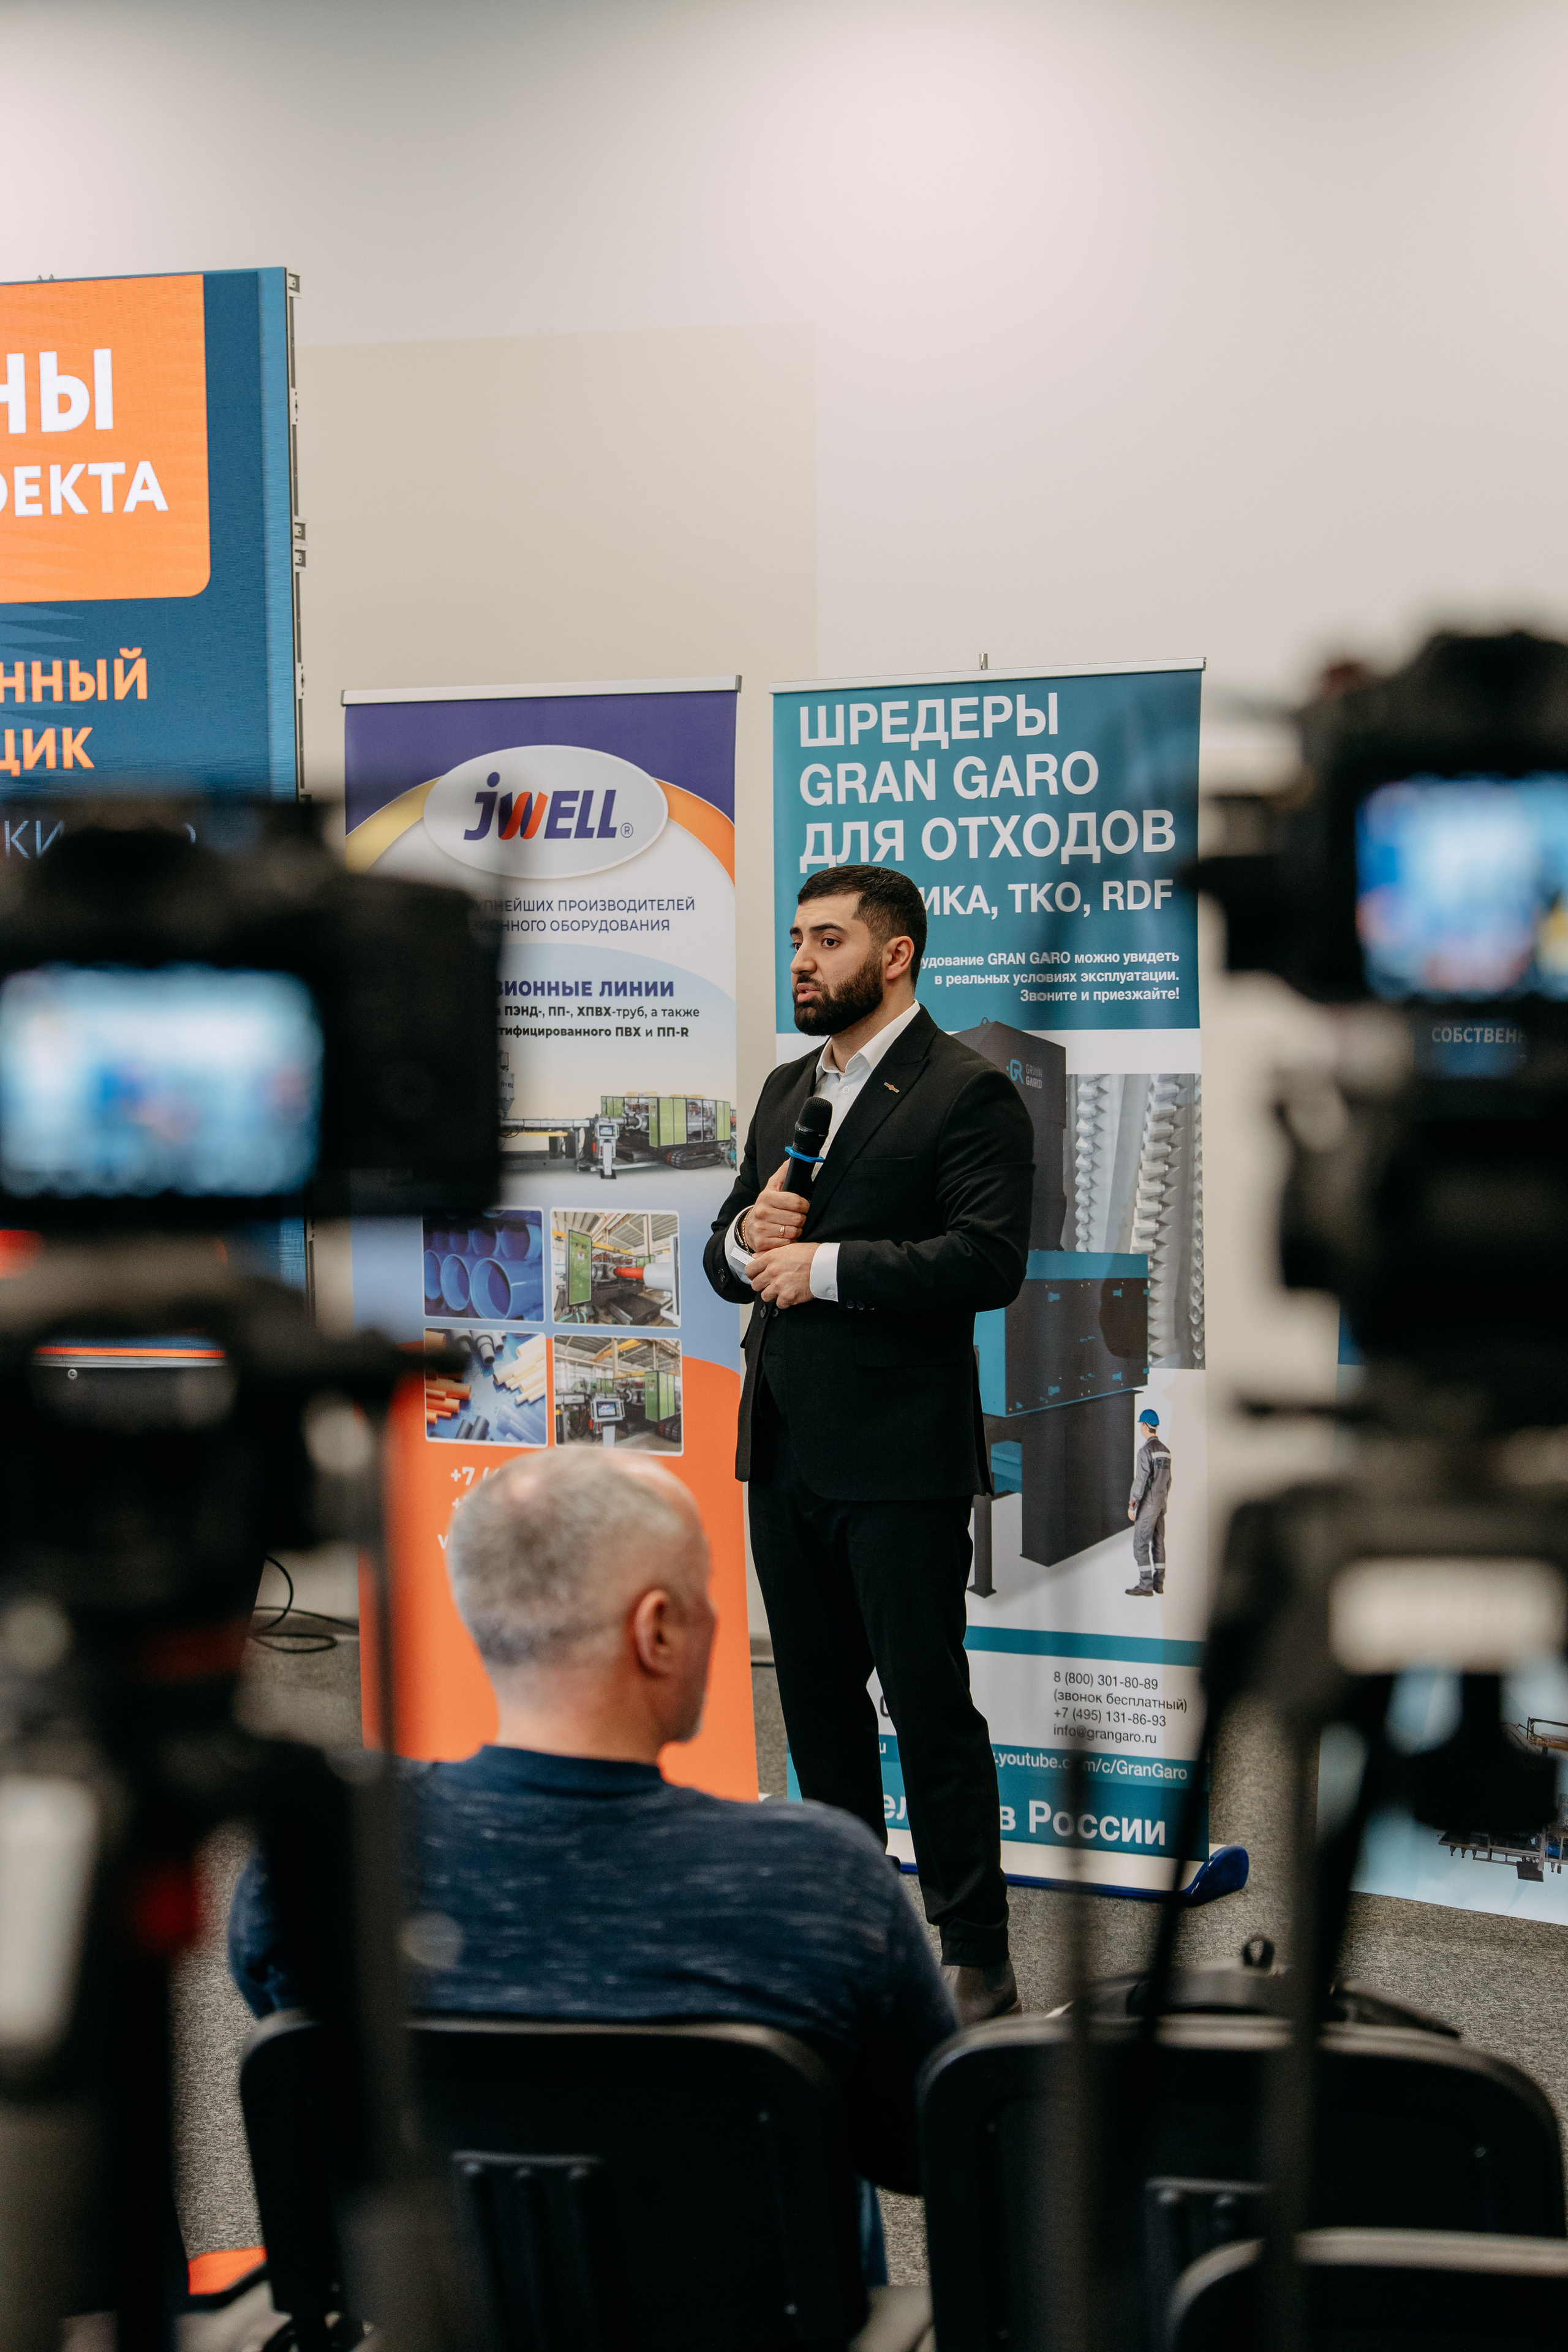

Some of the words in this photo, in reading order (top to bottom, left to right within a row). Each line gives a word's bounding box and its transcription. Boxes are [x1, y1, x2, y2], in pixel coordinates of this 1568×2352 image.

[0, 461, 169, 517] ЕКТА
[799, 692, 1058, 751] ШРЕДЕРЫ
[799, 758, 937, 807] GRAN
[953, 750, 1099, 800] GARO
[799, 819, 905, 874] ДЛЯ
[921, 810, 1176, 865] ОТХОДОВ
[558, 896, 695, 913] ПРОИЗВОДИТЕЛЕЙ
[919, 884, 998, 920] ИКА,
[1007, 881, 1091, 918] ТКО,
[1103, 879, 1174, 911] RDF
[550, 919, 670, 933] ОБОРУДОВАНИЯ
[921, 956, 984, 969] удование
[987, 952, 1025, 965] GRAN
[1029, 951, 1071, 965] GARO
[1074, 952, 1120, 963] можно
[1123, 952, 1180, 965] увидеть
[598, 981, 674, 997] ЛИНИИ
[934, 975, 943, 985] в
[945, 974, 1010, 987] реальных
[1013, 973, 1077, 986] условиях
[1080, 971, 1180, 984] эксплуатации.
[1020, 989, 1077, 1001] Звоните
[1081, 991, 1090, 1001] и
[1093, 986, 1180, 1003] приезжайте!
[504, 1006, 546, 1018] ПЭНД-,
[548, 1006, 574, 1018] ПП-,
[577, 1006, 647, 1019] ХПВХ-труб,
[661, 1008, 700, 1017] также
[497, 1025, 611, 1038] тифицированного
[615, 1027, 641, 1037] ПВХ
[645, 1028, 653, 1036] и
[657, 1027, 689, 1037] ПП-R
[1054, 1671, 1061, 1683] 8
[1065, 1672, 1093, 1687] (800)
[1098, 1674, 1159, 1690] 301-80-89
[1054, 1689, 1103, 1703] (звонок
[1106, 1693, 1188, 1714] бесплатный)
[1054, 1706, 1069, 1718] +7
[1072, 1707, 1102, 1723] (495)
[1106, 1711, 1167, 1727] 131-86-93
[1054, 1724, 1157, 1744] info@grangaro.ru
[993, 1752, 1188, 1780] .youtube.cm/c/GranGaro
[1029, 1800, 1166, 1846] России
